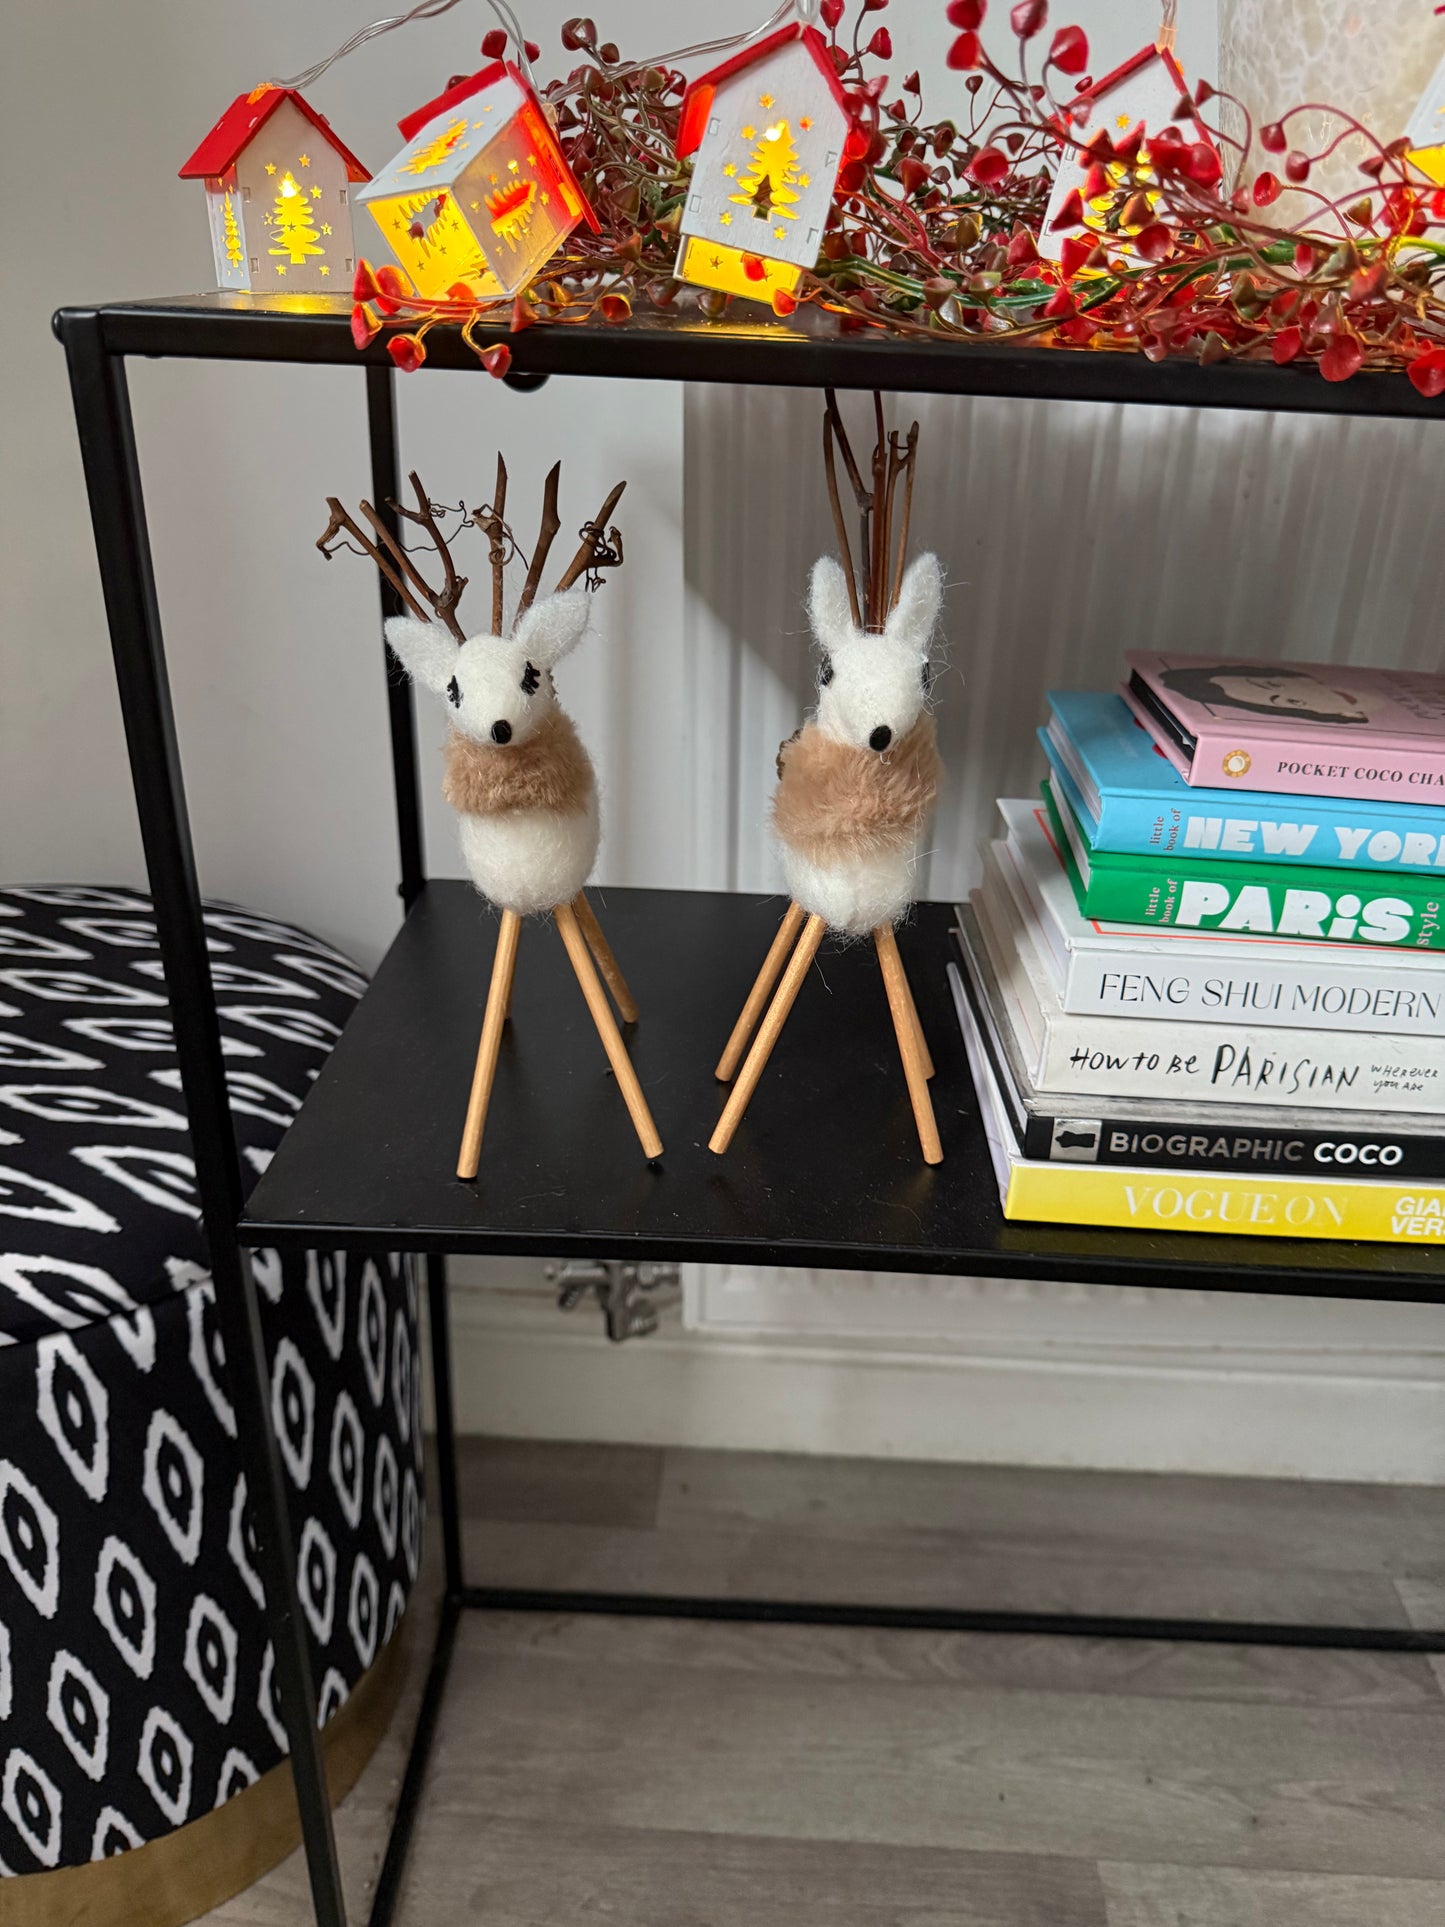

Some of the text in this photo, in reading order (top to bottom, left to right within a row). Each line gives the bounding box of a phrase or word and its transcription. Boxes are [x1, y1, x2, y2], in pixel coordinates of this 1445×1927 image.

[1277, 761, 1445, 786] POCKET COCO CHA
[1149, 816, 1165, 845] little
[1163, 808, 1181, 851] book of
[1183, 816, 1319, 856] NEW
[1145, 886, 1160, 916] little
[1158, 878, 1177, 923] book of
[1416, 901, 1440, 946] style
[1100, 973, 1443, 1019] FENG SHUI MODERN
[1210, 1044, 1359, 1094] PARISIAN
[1373, 1080, 1399, 1093] you
[1109, 1130, 1403, 1167] BIOGRAPHIC COCO
[1122, 1185, 1349, 1226] VOGUE ON
[1394, 1196, 1445, 1216] GIA
[1390, 1215, 1445, 1236] VER
